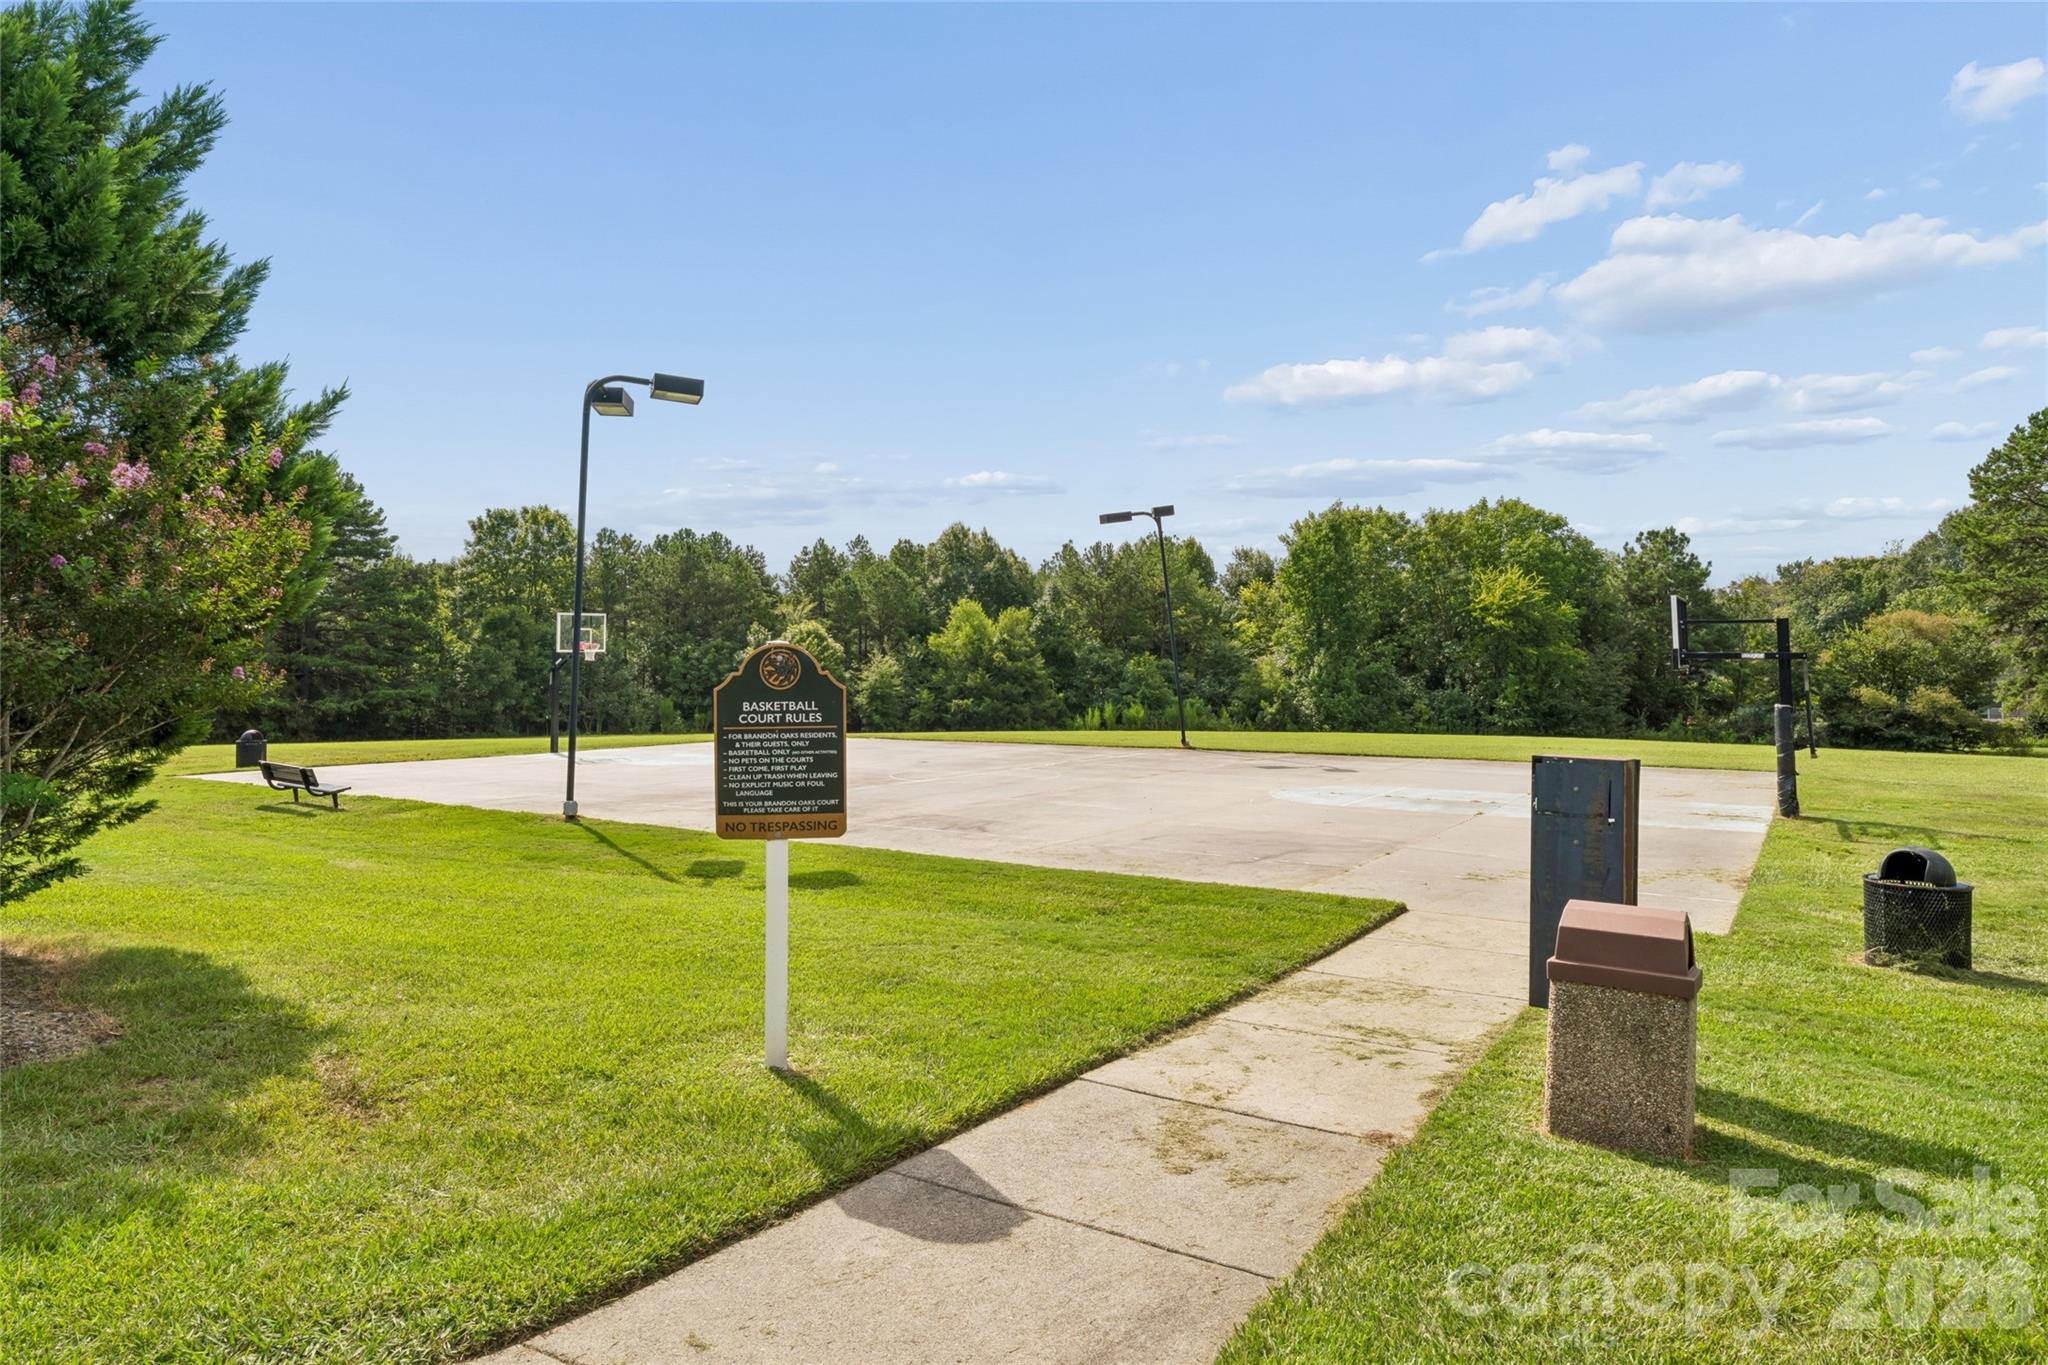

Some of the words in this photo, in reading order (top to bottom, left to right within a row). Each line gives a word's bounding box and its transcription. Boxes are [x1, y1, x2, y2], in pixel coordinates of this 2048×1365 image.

[742, 700, 818, 712] BASKETBALL
[738, 713, 782, 724] COURT
[785, 712, 822, 723] RULES
[725, 822, 747, 832] NO
[750, 820, 838, 832] TRESPASSING
